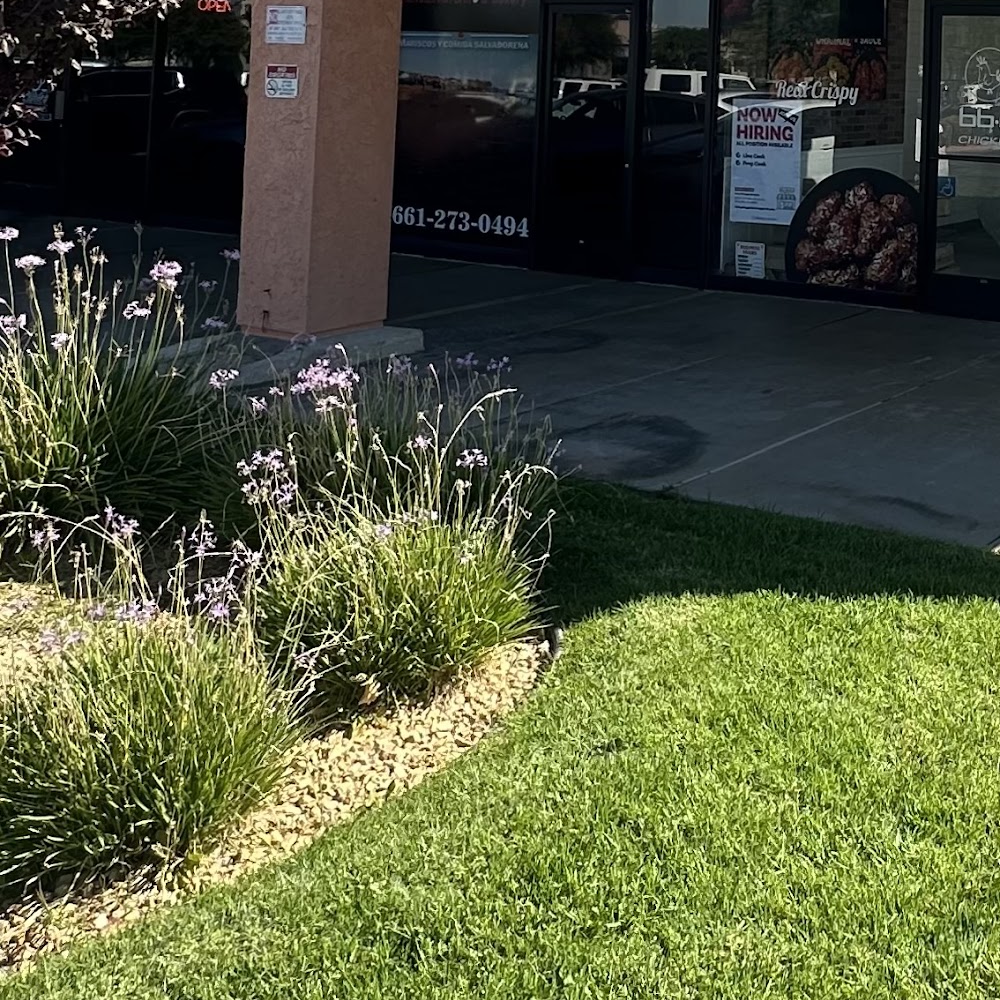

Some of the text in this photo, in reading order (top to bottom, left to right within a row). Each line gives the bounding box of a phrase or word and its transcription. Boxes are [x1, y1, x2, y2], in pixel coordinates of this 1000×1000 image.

[811, 81, 860, 106] Crispy
[737, 107, 777, 122] NOW
[736, 124, 794, 141] HIRING
[392, 205, 529, 238] 661-273-0494
